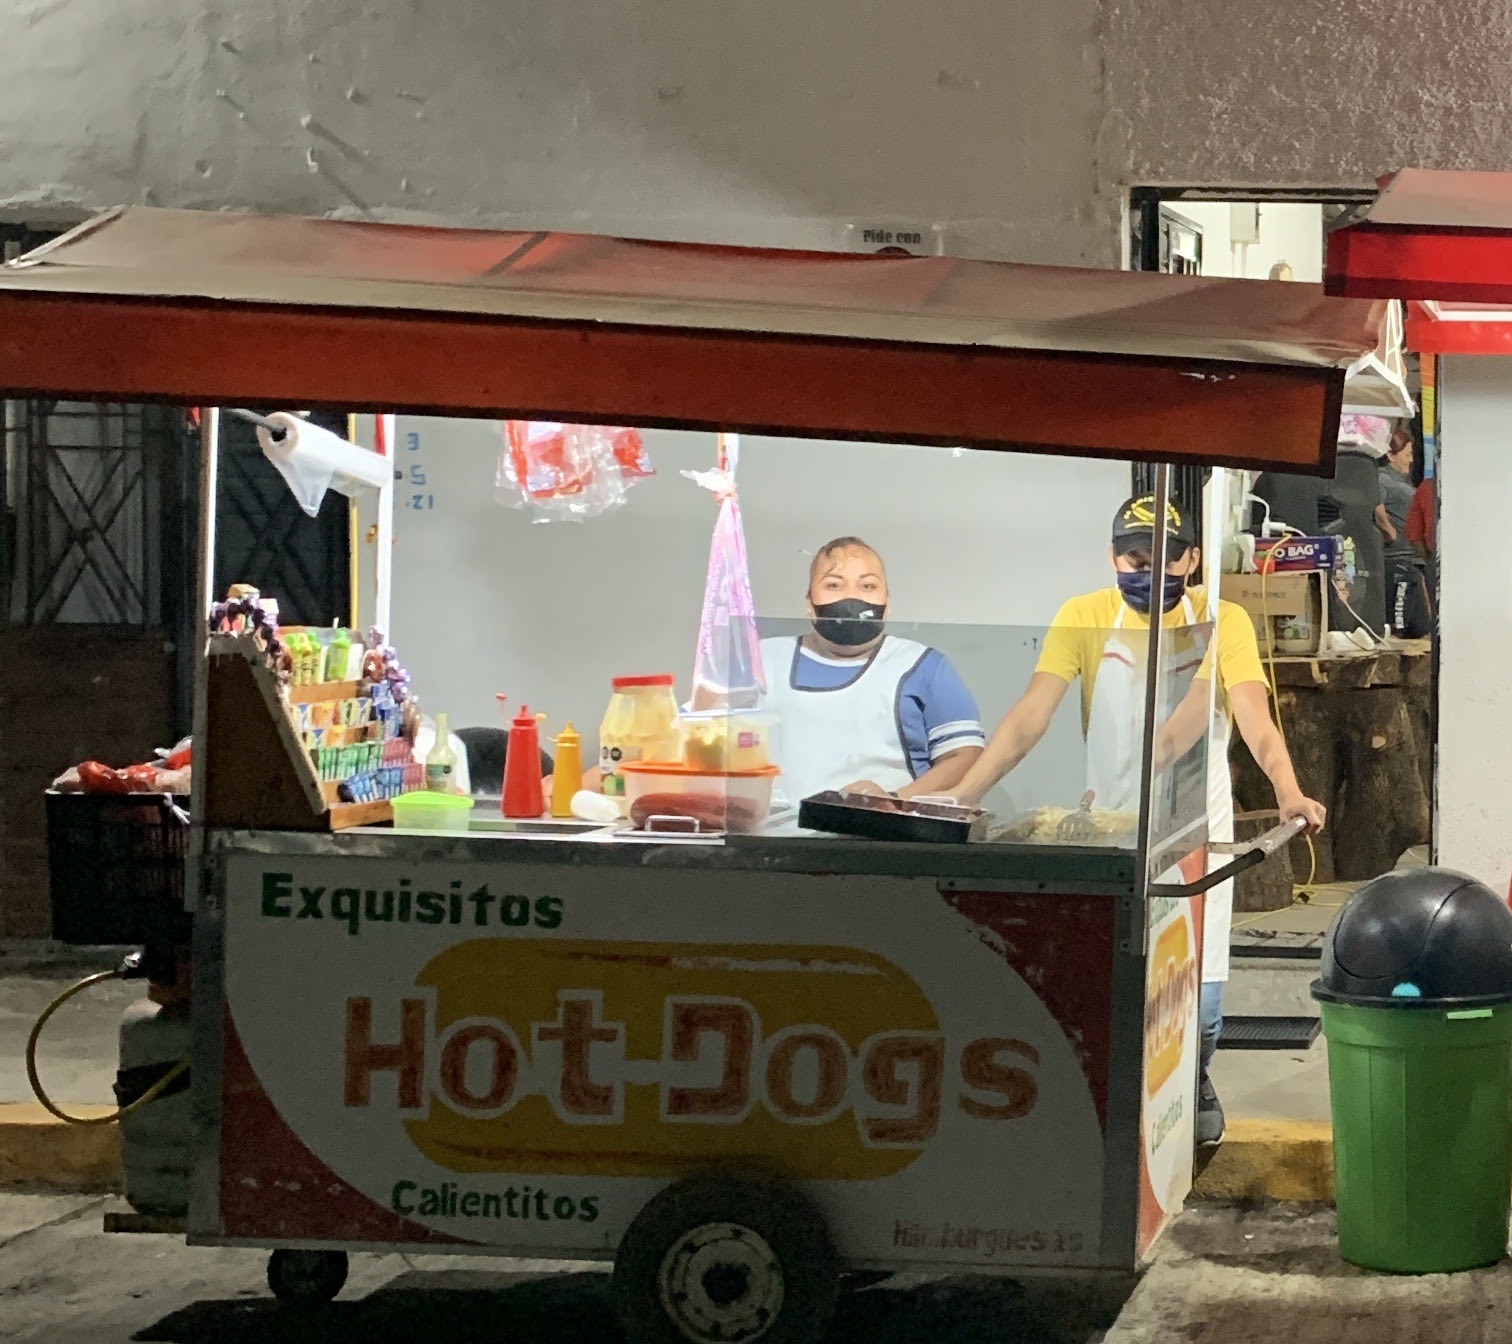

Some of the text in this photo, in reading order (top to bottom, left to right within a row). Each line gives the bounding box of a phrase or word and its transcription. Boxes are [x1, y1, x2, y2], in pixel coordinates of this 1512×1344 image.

[1287, 544, 1315, 557] BAG
[261, 872, 564, 936] Exquisitos
[390, 1179, 600, 1223] Calientitos
